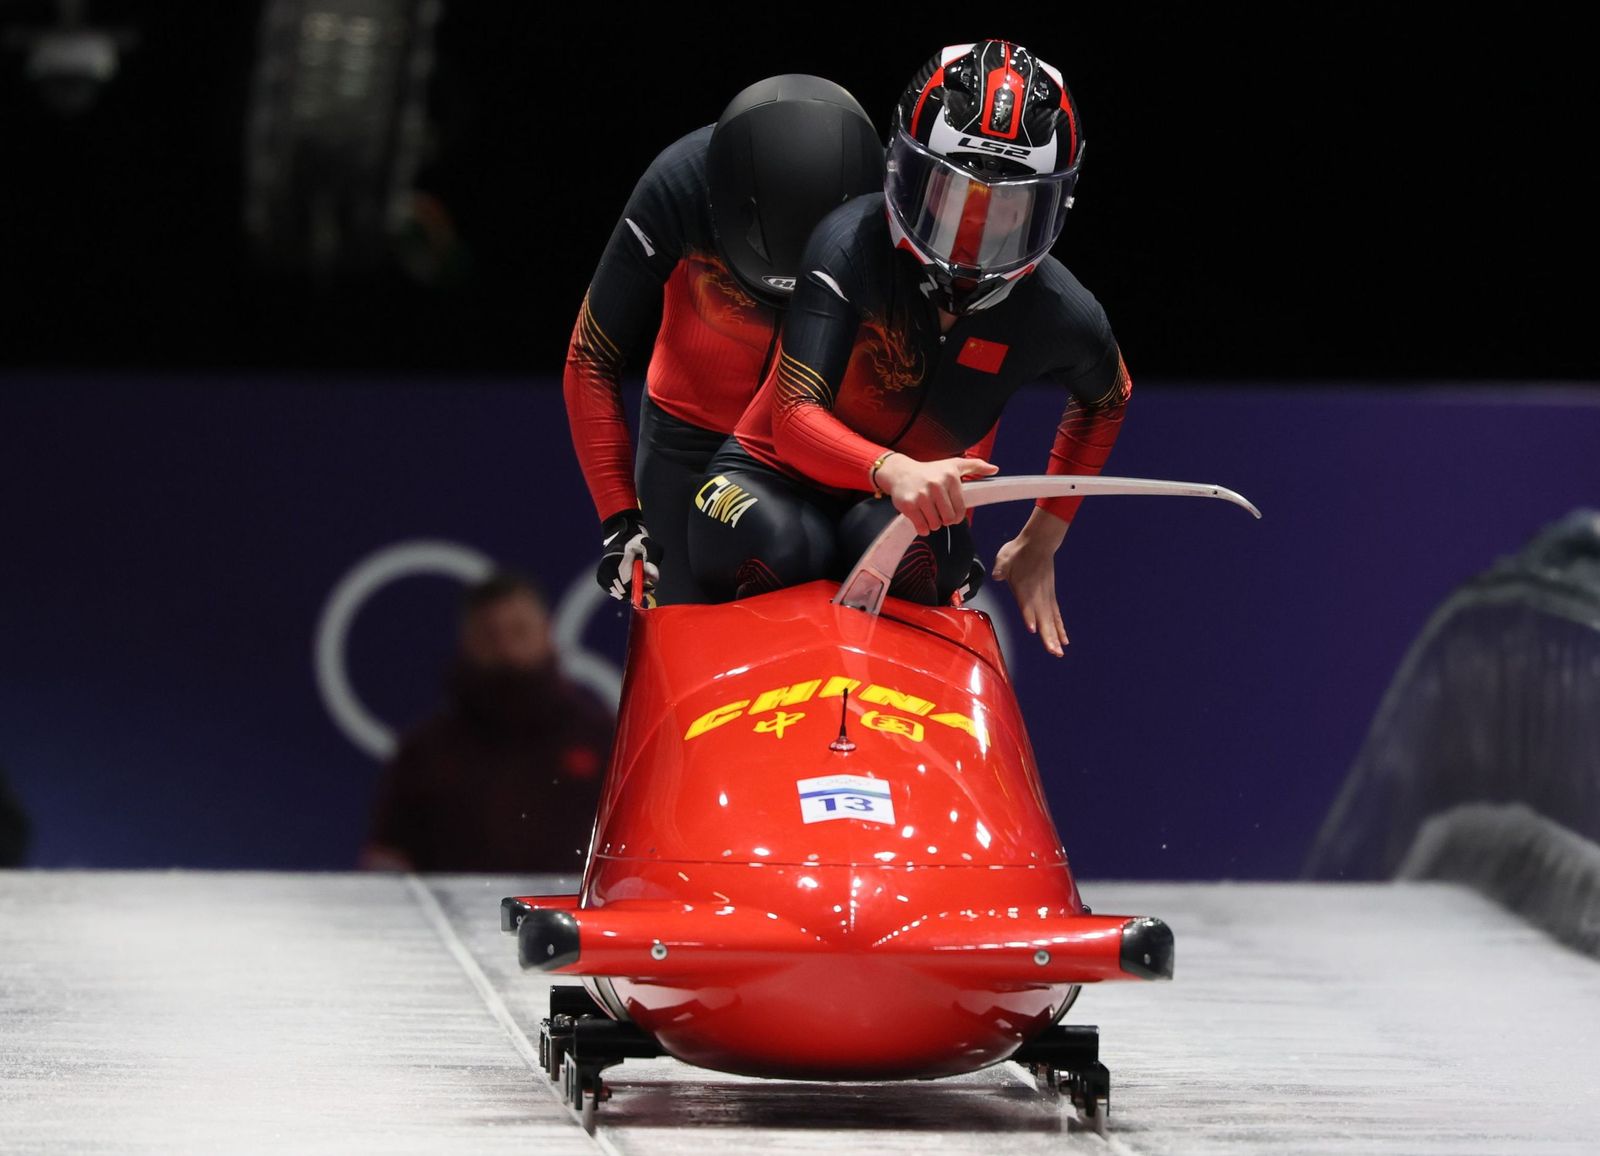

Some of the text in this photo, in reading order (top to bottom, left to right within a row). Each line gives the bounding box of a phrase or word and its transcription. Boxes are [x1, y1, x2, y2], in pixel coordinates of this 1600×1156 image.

[957, 137, 1031, 160] LS2
[694, 475, 759, 529] CHINA
[684, 676, 991, 747] CHINA
[818, 796, 875, 812] 13
